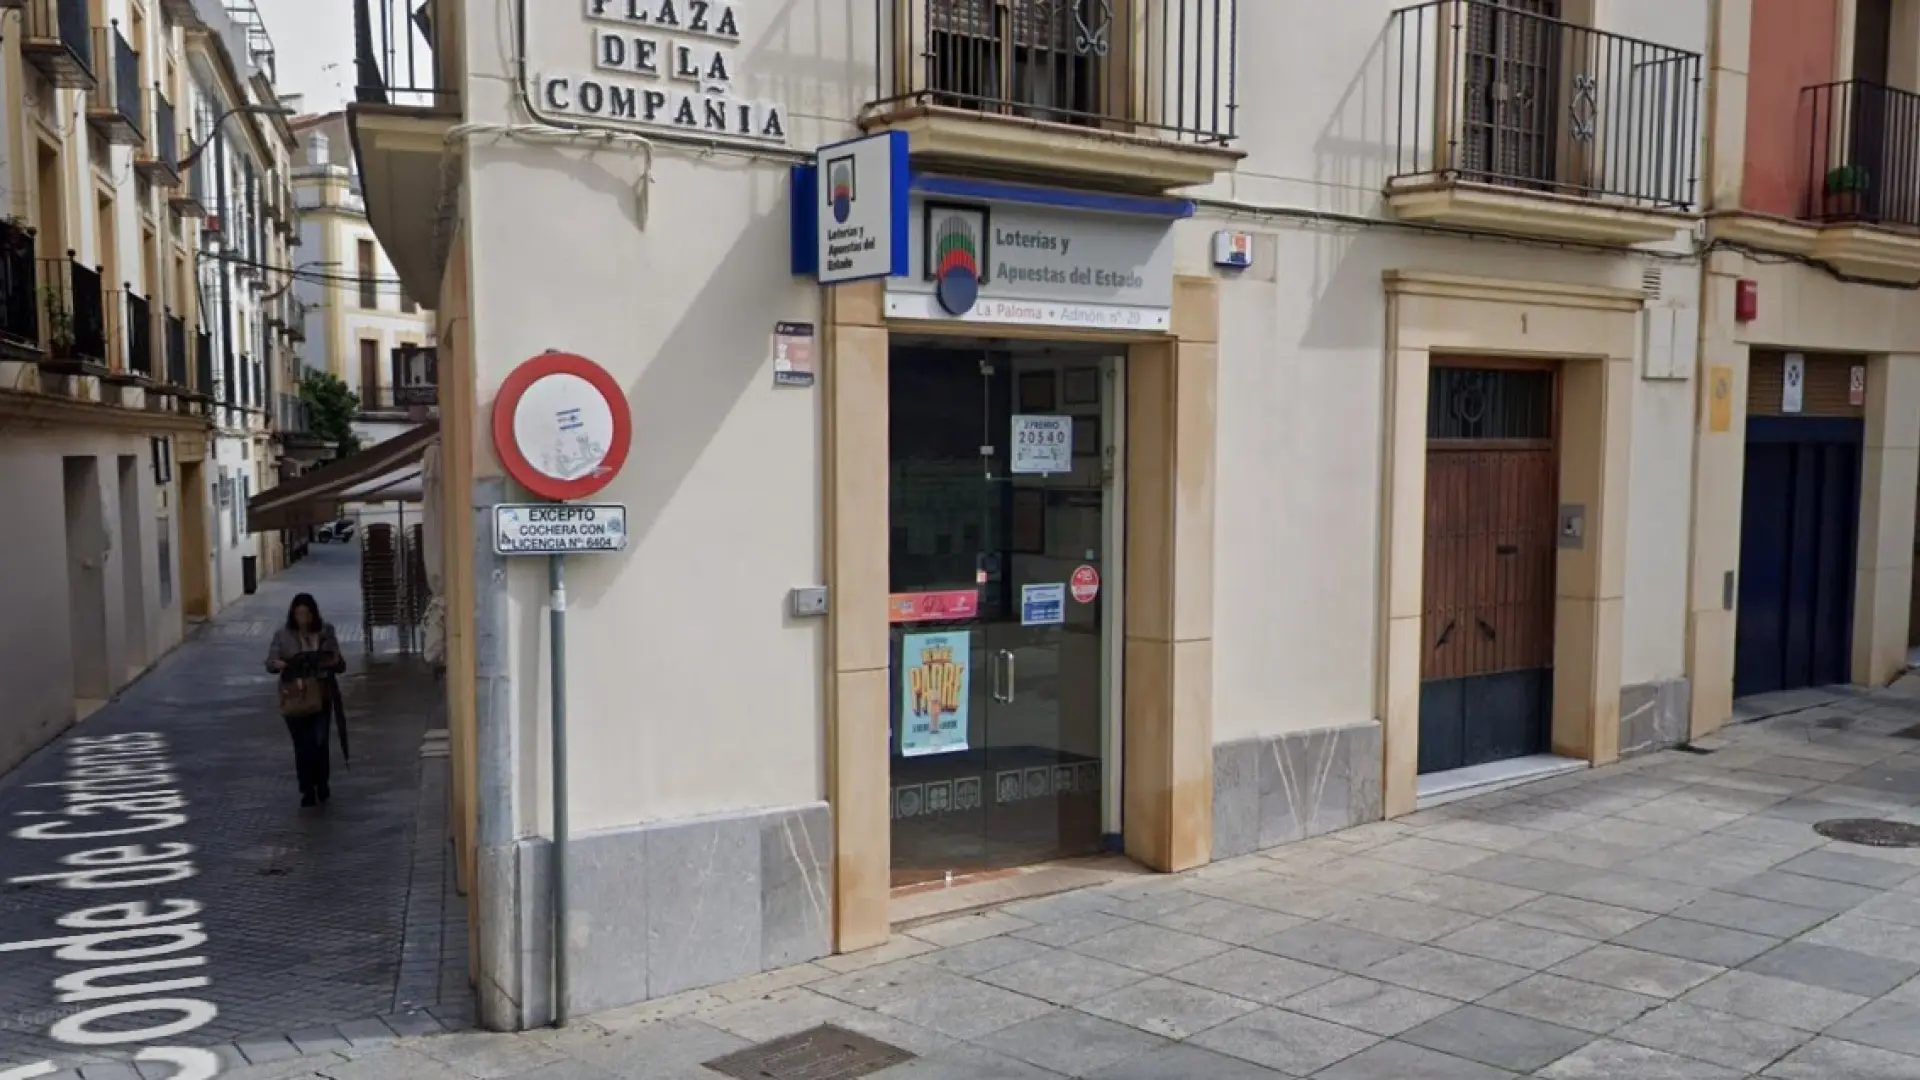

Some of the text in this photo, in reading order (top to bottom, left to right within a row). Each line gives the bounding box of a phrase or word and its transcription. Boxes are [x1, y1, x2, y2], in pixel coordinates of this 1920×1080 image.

[602, 35, 729, 81] DE LA
[546, 79, 784, 137] COMPAÑIA
[1061, 238, 1070, 255] y
[828, 258, 853, 271] Estado
[996, 262, 1143, 288] Apuestas del Estado
[976, 302, 991, 316] La
[997, 304, 1043, 319] Paloma
[1521, 312, 1528, 334] 1
[1018, 431, 1066, 444] 20540
[528, 507, 596, 521] EXCEPTO
[520, 523, 605, 536] COCHERA CON
